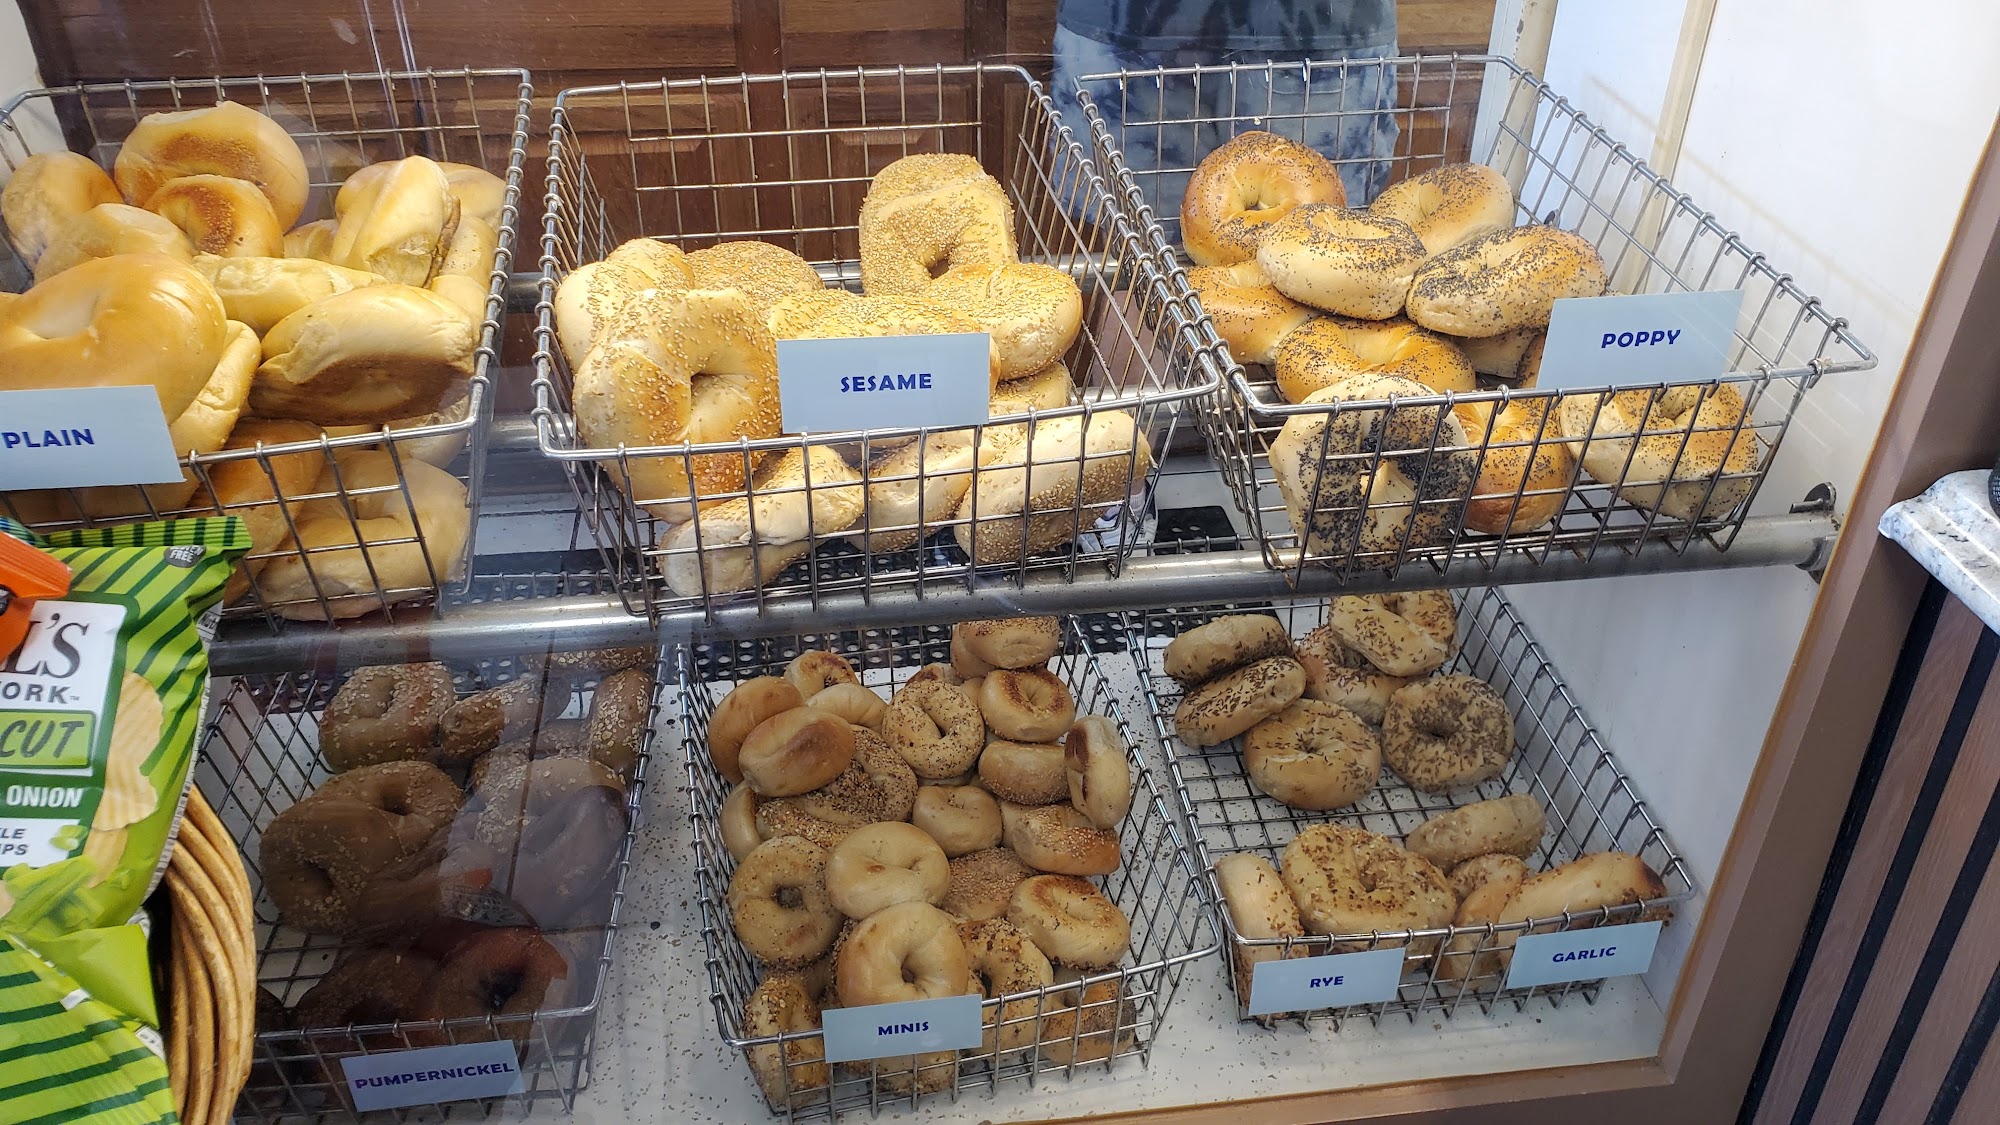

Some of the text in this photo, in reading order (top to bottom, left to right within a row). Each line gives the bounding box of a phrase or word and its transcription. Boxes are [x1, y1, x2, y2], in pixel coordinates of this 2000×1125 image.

[1601, 329, 1681, 349] POPPY
[840, 373, 932, 393] SESAME
[1, 428, 95, 449] PLAIN
[169, 549, 195, 563] FREE
[0, 682, 71, 704] ORK
[0, 720, 85, 759] CUT
[6, 784, 84, 808] ONION
[0, 828, 27, 839] LE
[1552, 946, 1617, 963] GARLIC
[1310, 975, 1344, 988] RYE
[878, 1021, 929, 1036] MINIS
[354, 1062, 515, 1089] PUMPERNICKEL
